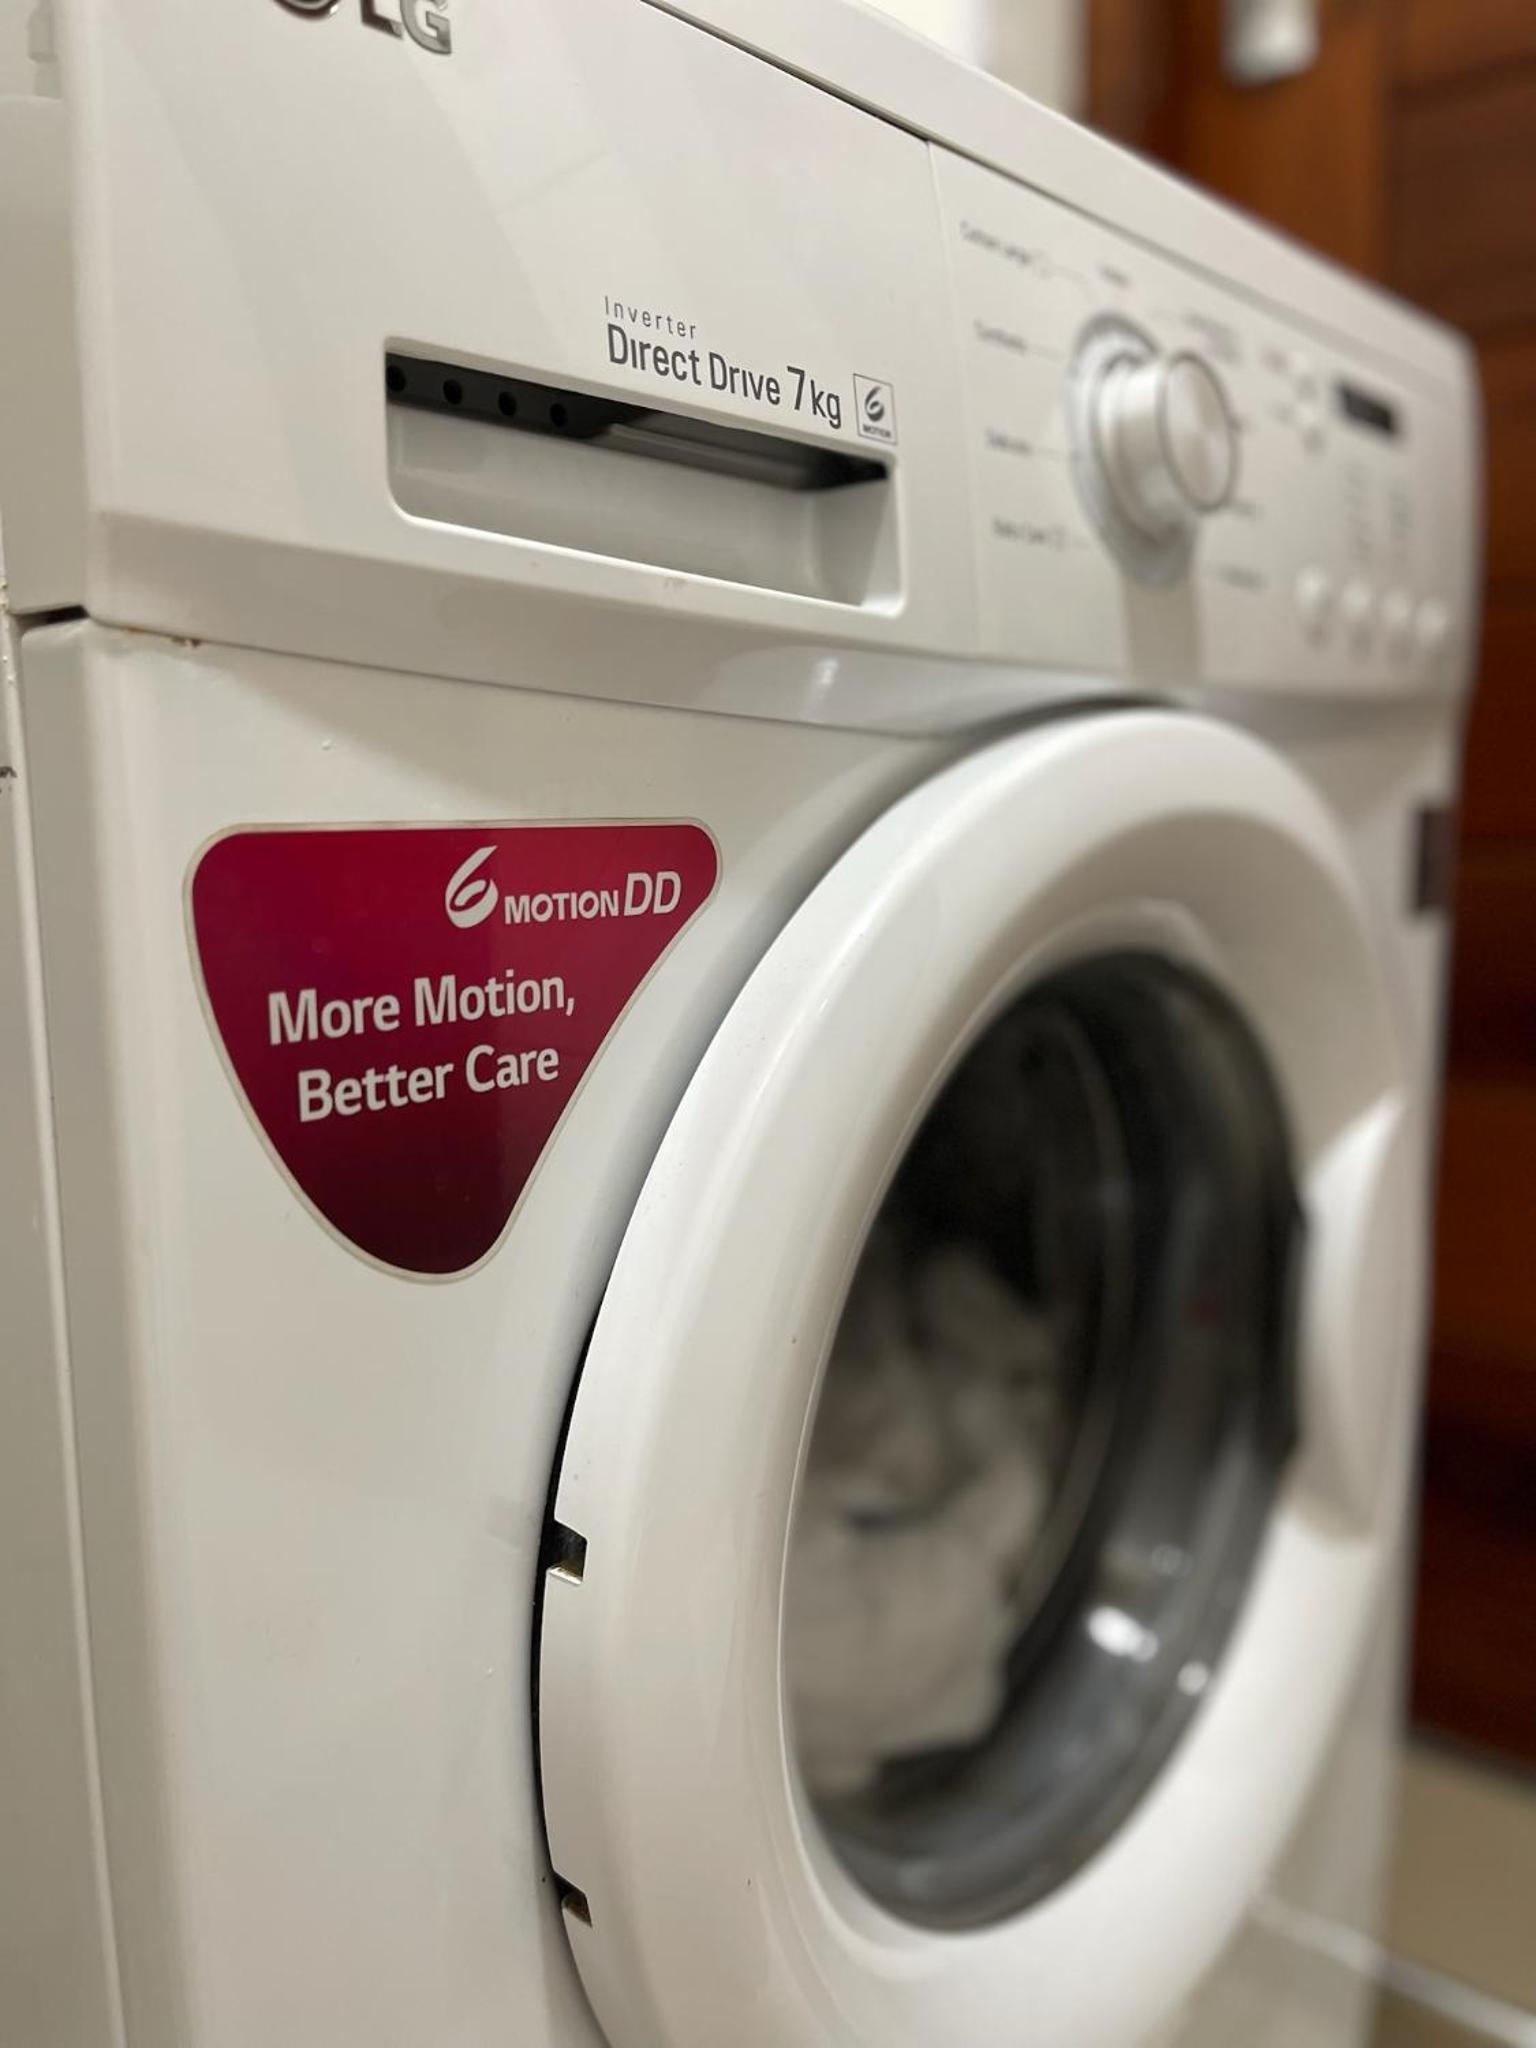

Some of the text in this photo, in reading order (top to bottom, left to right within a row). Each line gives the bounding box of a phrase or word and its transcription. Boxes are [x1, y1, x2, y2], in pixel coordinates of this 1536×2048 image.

[604, 295, 697, 339] Inverter
[606, 323, 702, 386] Direct
[709, 351, 782, 406] Drive
[504, 889, 619, 926] MOTION
[623, 870, 682, 917] DD
[268, 969, 576, 1046] More Motion,
[298, 1044, 560, 1123] Better Care
